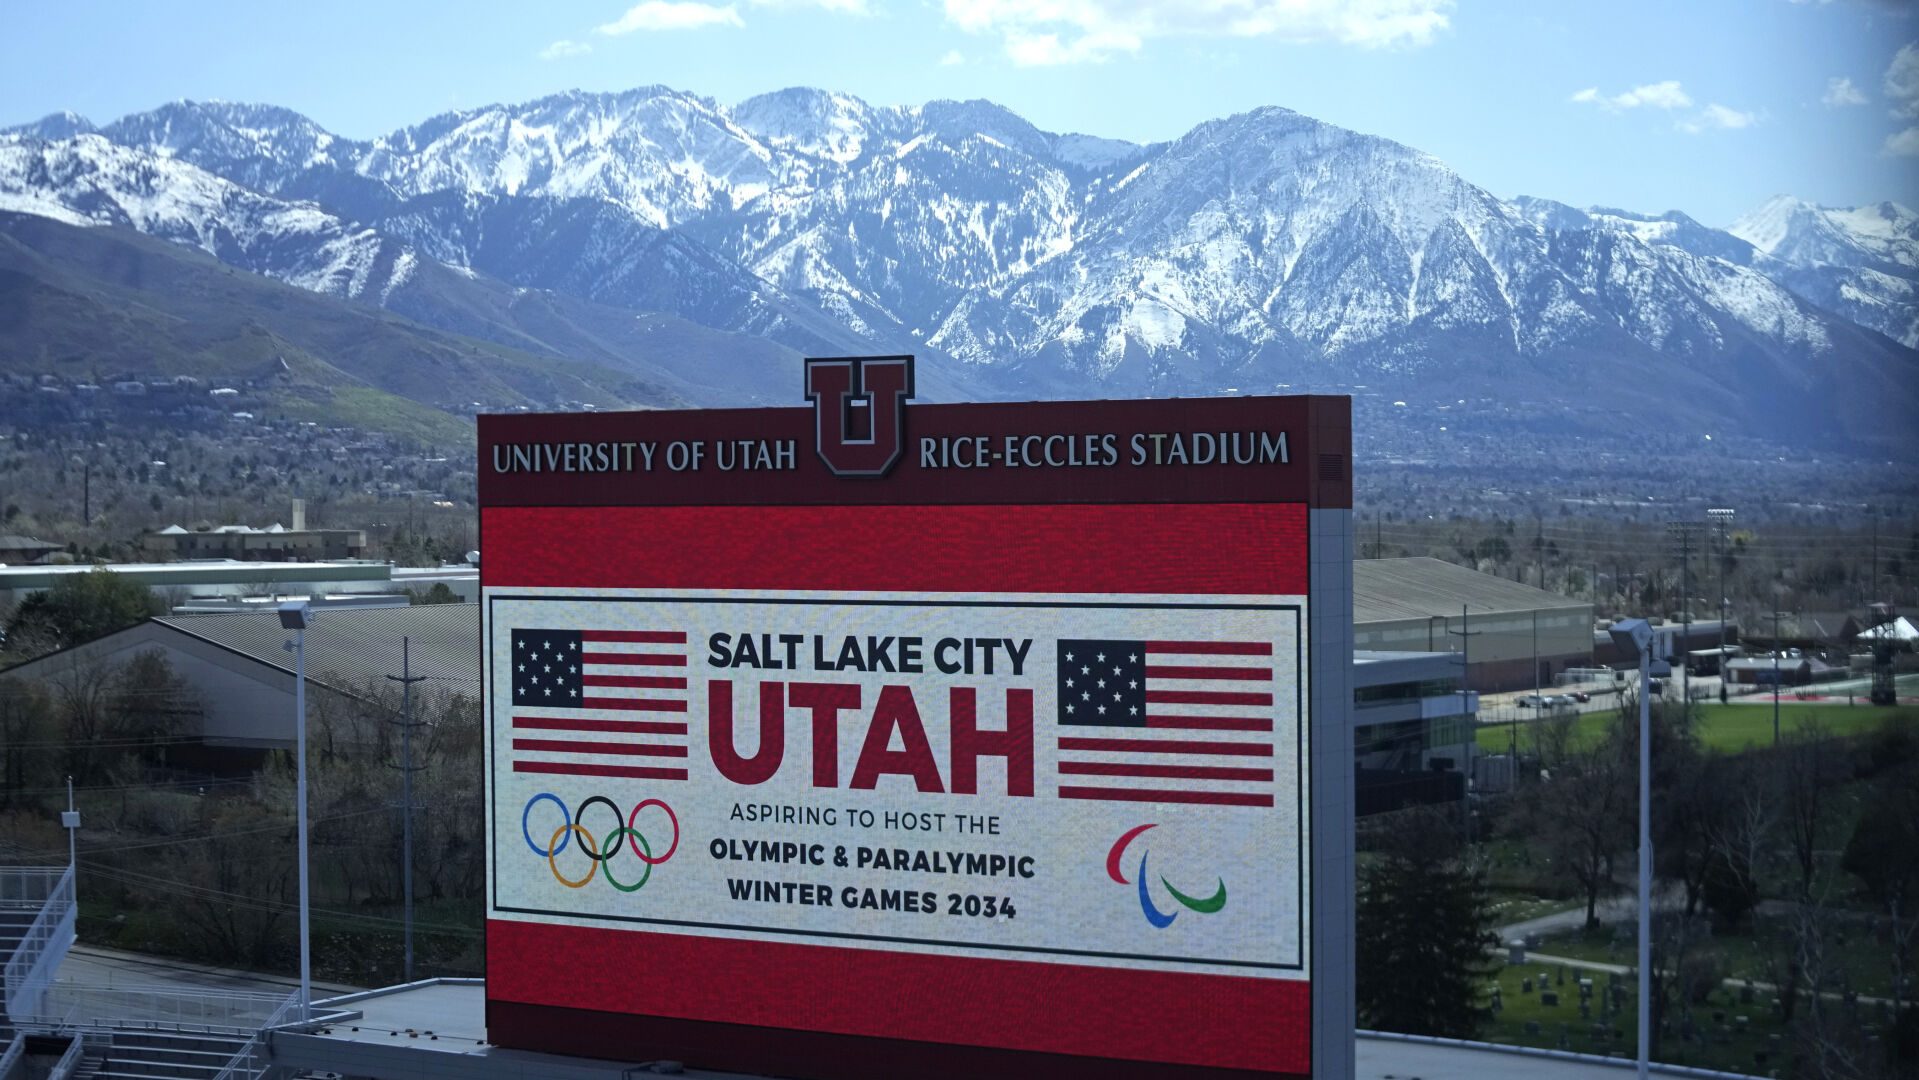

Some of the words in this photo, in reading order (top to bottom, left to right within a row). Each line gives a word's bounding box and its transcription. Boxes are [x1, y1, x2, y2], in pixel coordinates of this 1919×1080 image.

[804, 355, 915, 479] U
[493, 441, 657, 473] UNIVERSITY
[666, 441, 705, 471] OF
[717, 440, 796, 471] UTAH
[920, 433, 1118, 468] RICE-ECCLES
[1130, 431, 1289, 466] STADIUM
[707, 632, 804, 670] SALT
[814, 635, 924, 674] LAKE
[933, 637, 1033, 676] CITY
[708, 679, 1035, 797] UTAH
[730, 803, 837, 826] ASPIRING
[846, 809, 875, 828] TO
[884, 811, 946, 832] HOST
[955, 815, 1001, 835] THE
[709, 838, 825, 866] OLYMPIC
[833, 845, 848, 867] &
[857, 846, 1036, 879] PARALYMPIC
[727, 878, 833, 906] WINTER
[841, 886, 937, 914] GAMES
[947, 893, 1017, 919] 2034
